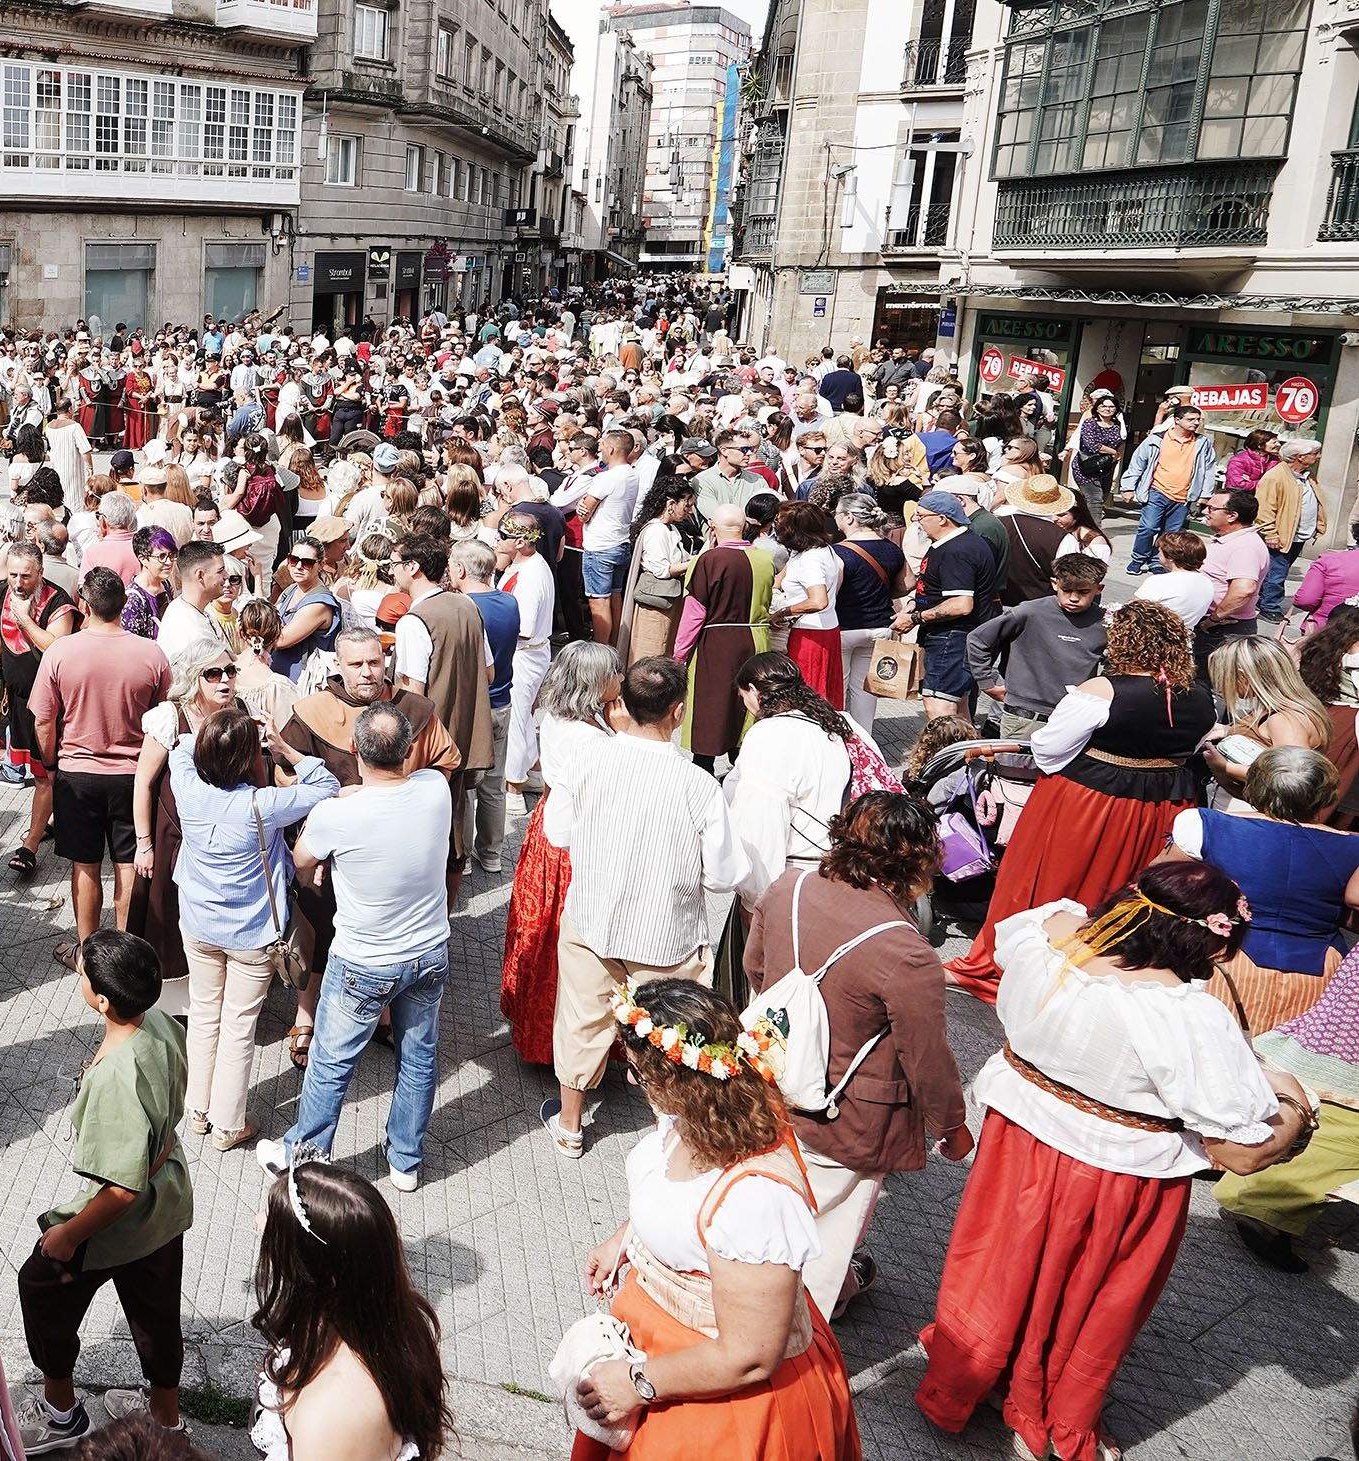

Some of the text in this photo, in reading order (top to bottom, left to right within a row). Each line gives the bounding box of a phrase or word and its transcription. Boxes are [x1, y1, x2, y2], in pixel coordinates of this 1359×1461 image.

[985, 319, 1058, 339] ARESSO
[1197, 333, 1313, 359] ARESSO
[982, 356, 1002, 377] 70
[1189, 388, 1263, 407] REBAJAS
[1280, 387, 1315, 414] 70
